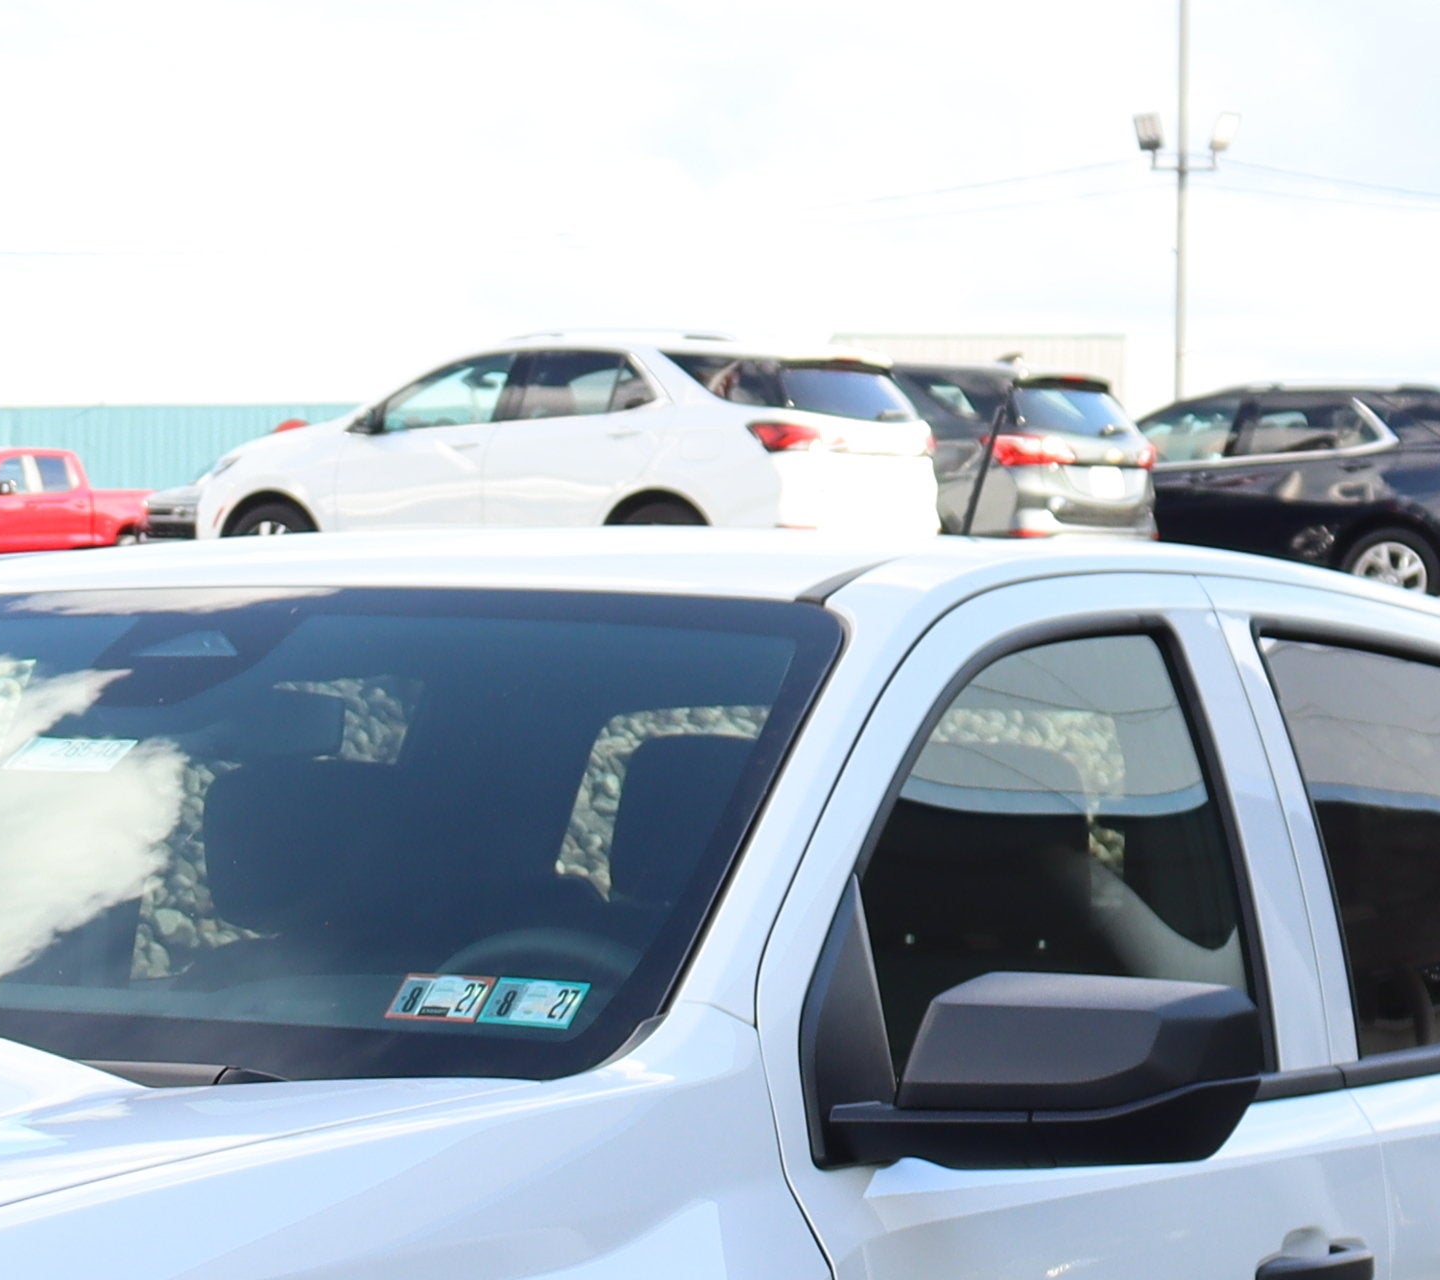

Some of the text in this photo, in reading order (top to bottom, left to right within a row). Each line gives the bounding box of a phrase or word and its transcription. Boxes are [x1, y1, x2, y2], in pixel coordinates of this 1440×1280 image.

[401, 982, 487, 1013] 8 27
[496, 988, 580, 1020] 8 27
